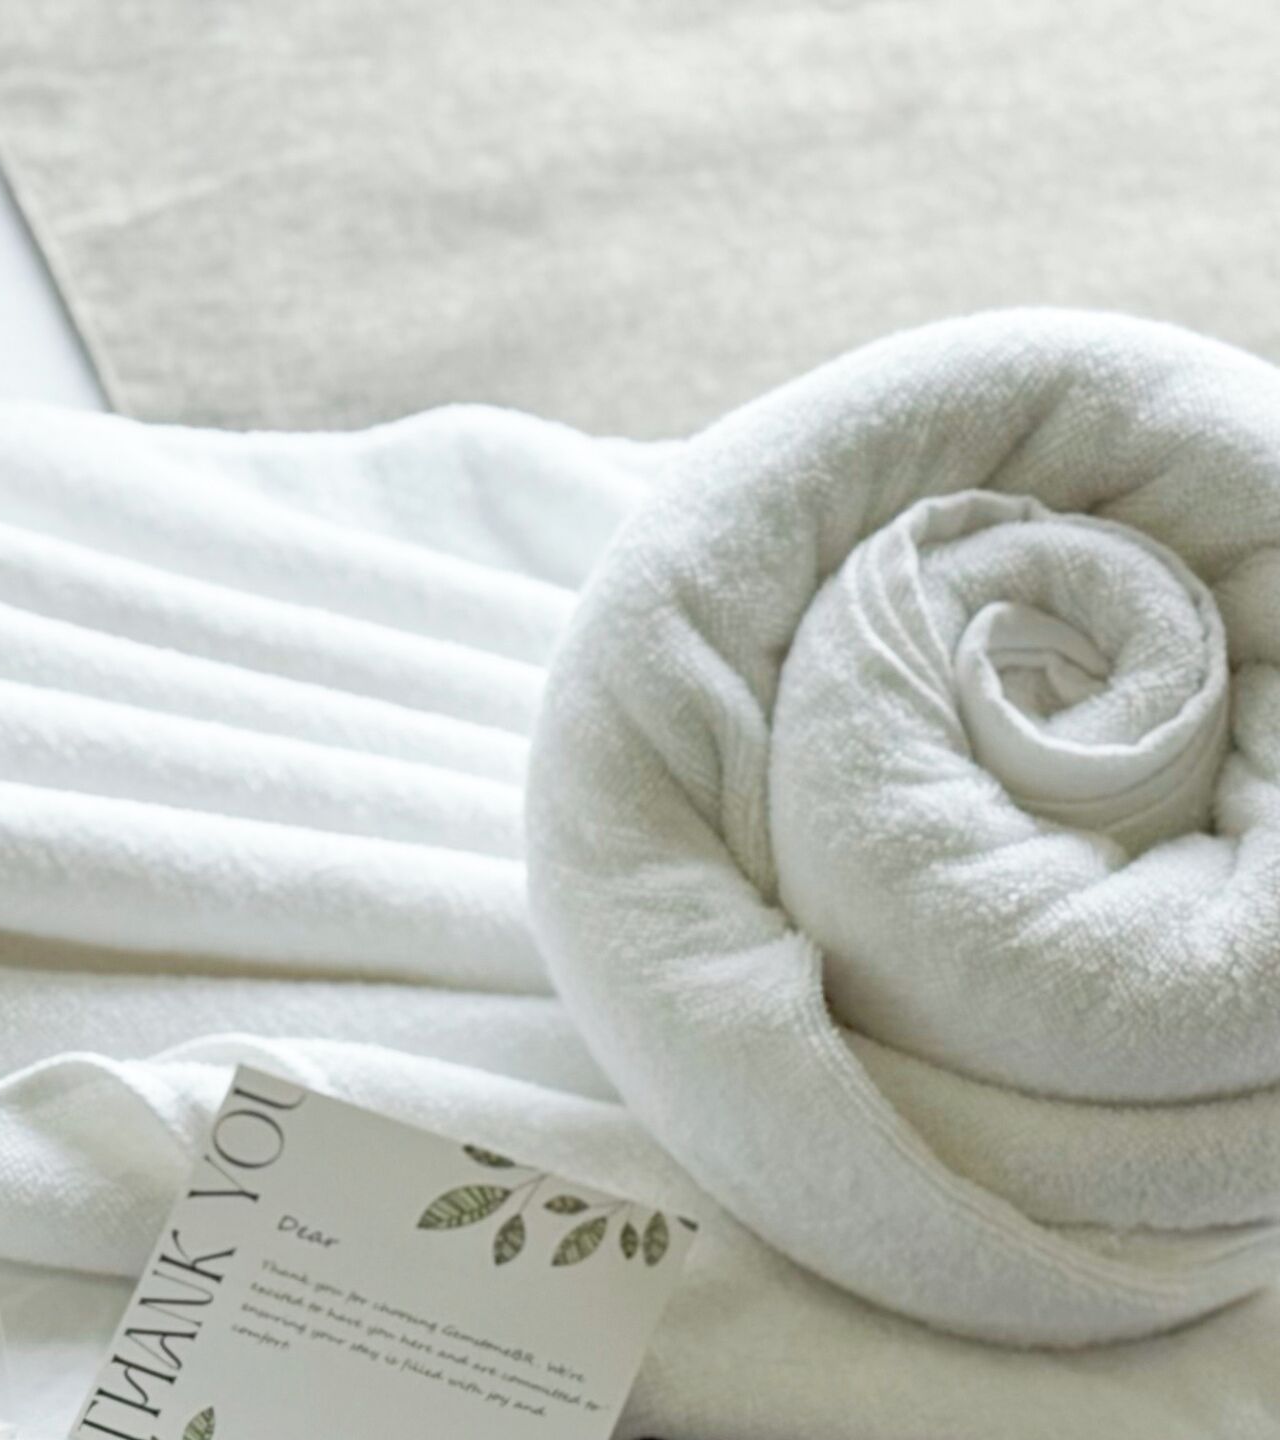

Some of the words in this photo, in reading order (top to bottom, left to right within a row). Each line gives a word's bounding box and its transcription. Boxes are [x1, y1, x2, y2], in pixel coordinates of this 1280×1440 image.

[186, 1086, 307, 1204] YOU
[276, 1214, 339, 1249] Dear
[261, 1259, 310, 1286] Thank
[313, 1282, 343, 1297] you
[345, 1290, 368, 1306] for
[372, 1302, 439, 1335] choosing
[240, 1302, 308, 1336] ensuring
[310, 1329, 347, 1346] your
[349, 1343, 380, 1361] stay
[384, 1355, 399, 1366] is
[400, 1357, 444, 1381] filled
[447, 1377, 484, 1395] with
[484, 1391, 511, 1408] joy
[512, 1401, 546, 1417] and
[307, 1302, 323, 1313] to
[325, 1307, 363, 1329] have
[366, 1325, 397, 1341] you
[399, 1334, 433, 1354] here
[436, 1349, 469, 1366] and
[471, 1362, 497, 1377] are
[500, 1372, 582, 1406] committed
